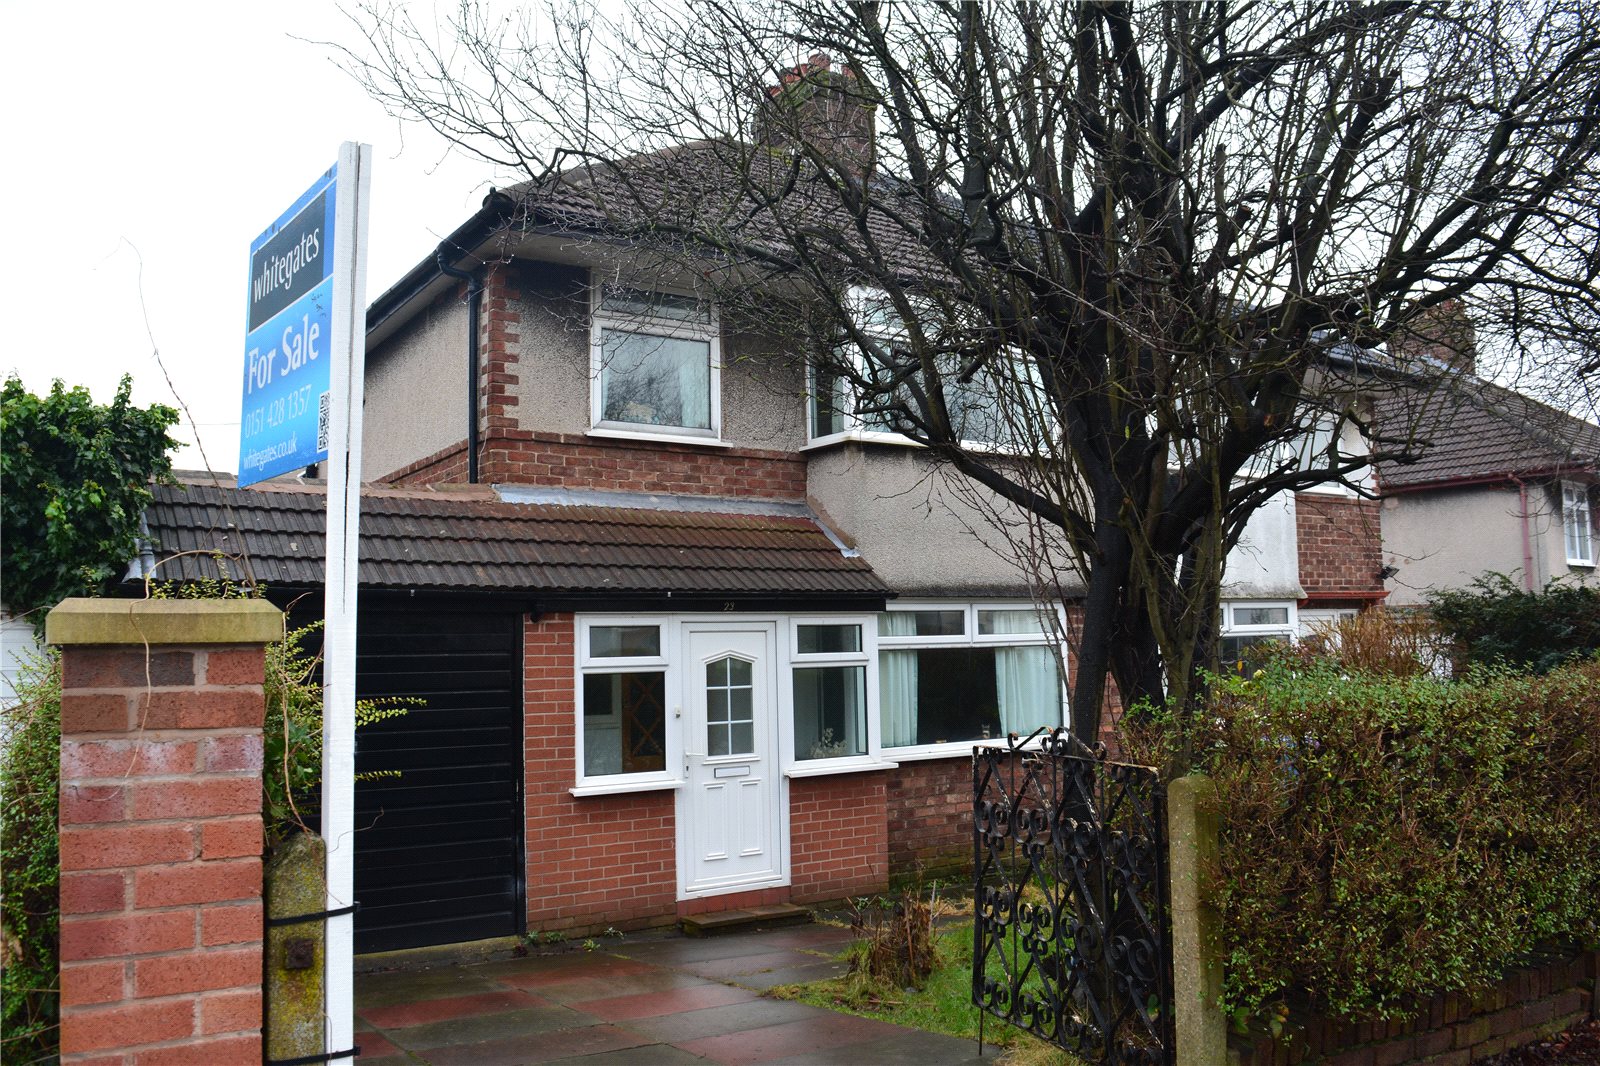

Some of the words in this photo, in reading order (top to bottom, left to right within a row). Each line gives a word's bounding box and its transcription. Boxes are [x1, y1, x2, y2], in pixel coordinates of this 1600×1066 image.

[254, 227, 320, 303] whitegates
[248, 347, 276, 394] For
[281, 313, 320, 376] Sale
[245, 409, 265, 439] 0151
[267, 399, 285, 428] 428
[288, 384, 312, 420] 1357
[243, 431, 298, 471] whitegates.co.uk
